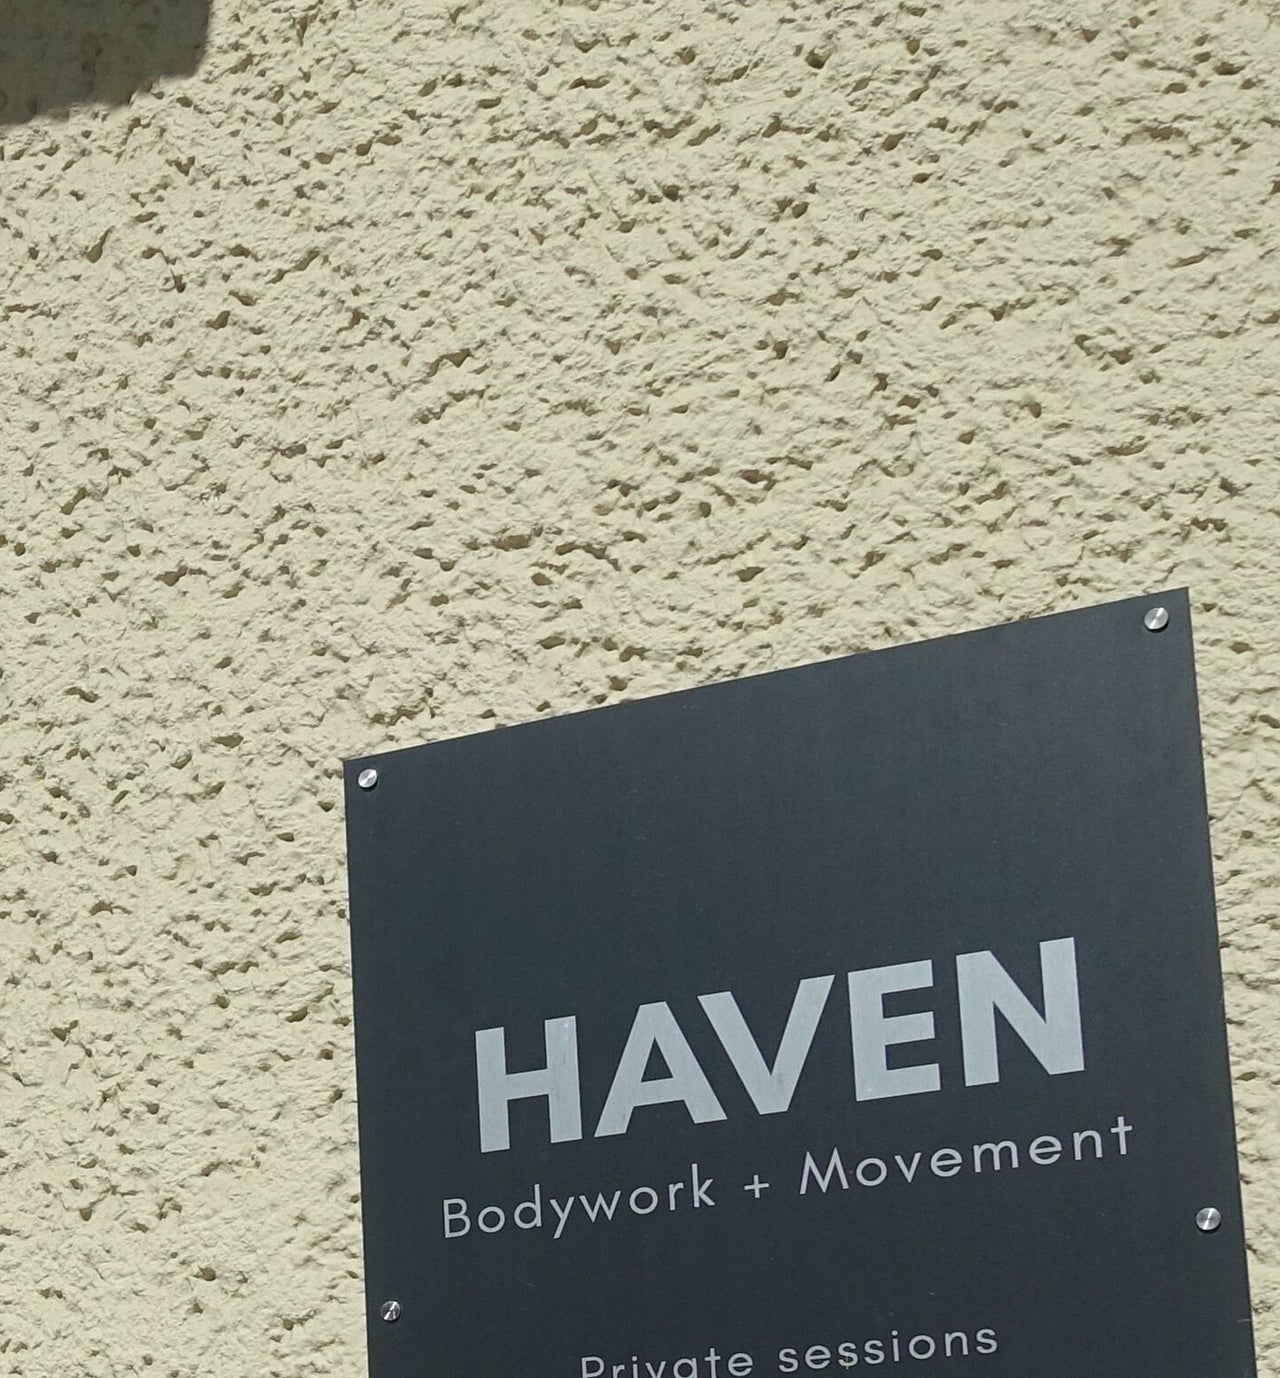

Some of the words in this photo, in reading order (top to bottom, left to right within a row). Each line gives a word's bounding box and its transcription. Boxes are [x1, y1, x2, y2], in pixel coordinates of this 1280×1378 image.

[475, 937, 1084, 1153] HAVEN
[444, 1163, 715, 1239] Bodywork
[744, 1174, 770, 1199] +
[800, 1116, 1133, 1195] Movement
[778, 1328, 998, 1373] sessions
